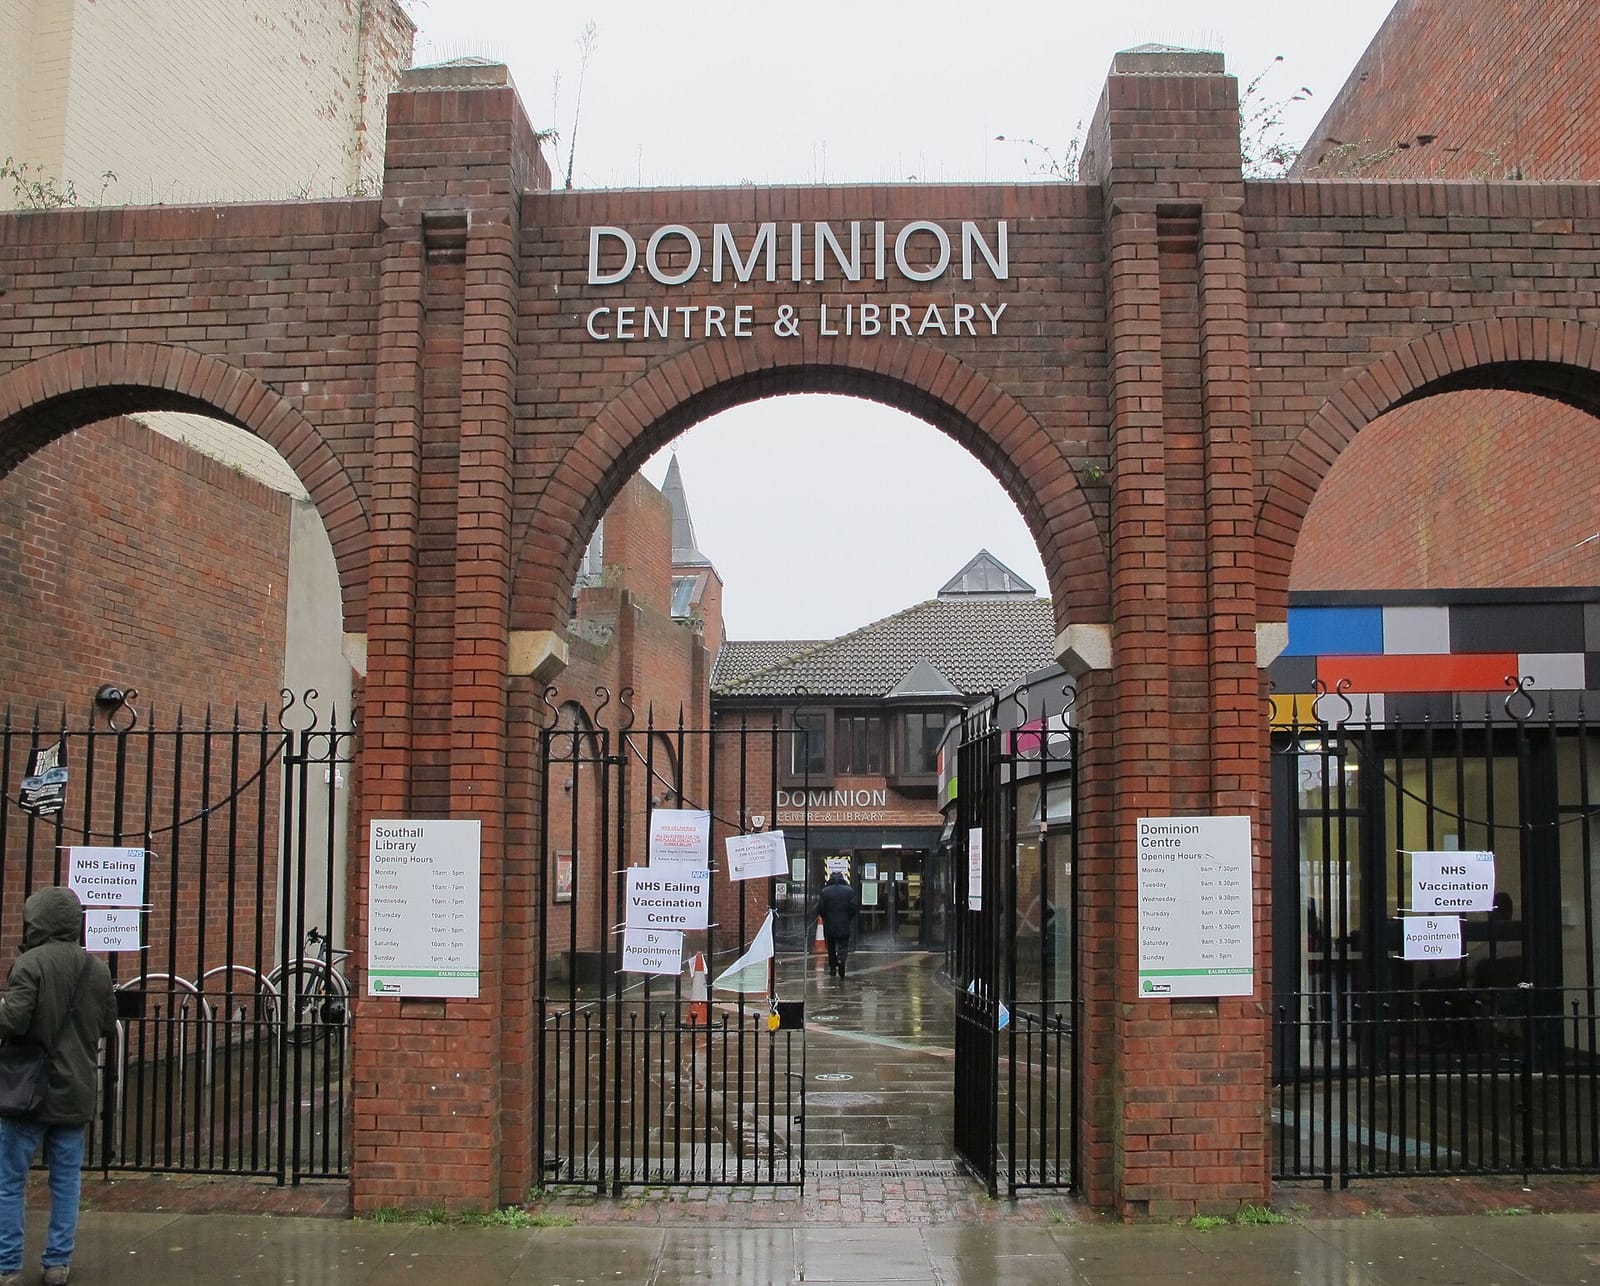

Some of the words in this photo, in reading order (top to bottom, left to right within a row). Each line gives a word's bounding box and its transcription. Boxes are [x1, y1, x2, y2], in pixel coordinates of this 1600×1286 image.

[588, 221, 1009, 285] DOMINION
[586, 305, 753, 340] CENTRE
[774, 304, 800, 337] &
[820, 303, 1008, 336] LIBRARY
[776, 789, 886, 807] DOMINION
[776, 812, 824, 822] CENTRE
[837, 812, 886, 821] LIBRARY
[375, 827, 424, 838] Southall
[1141, 824, 1199, 834] Dominion
[375, 840, 417, 852] Library
[1141, 837, 1181, 847] Centre
[375, 855, 408, 864] Opening
[1141, 853, 1175, 861] Opening
[1177, 852, 1202, 860] Hours
[77, 860, 99, 869] NHS
[102, 861, 136, 872] Ealing
[1441, 866, 1466, 875] NHS
[74, 875, 137, 885] Vaccination
[635, 882, 660, 891] NHS
[664, 882, 700, 894] Ealing
[1419, 881, 1488, 890] Vaccination
[87, 890, 122, 899] Centre
[633, 897, 702, 907] Vaccination
[1434, 897, 1472, 906] Centre
[107, 914, 117, 923] By
[374, 911, 401, 919] Thursday
[647, 913, 686, 923] Centre
[87, 925, 138, 934] Appointment
[1426, 920, 1438, 929] By
[103, 937, 122, 945] Only
[647, 934, 659, 943] By
[1406, 932, 1459, 942] Appointment
[625, 945, 680, 955] Appointment
[1423, 944, 1443, 953] Only
[642, 958, 662, 967] Only
